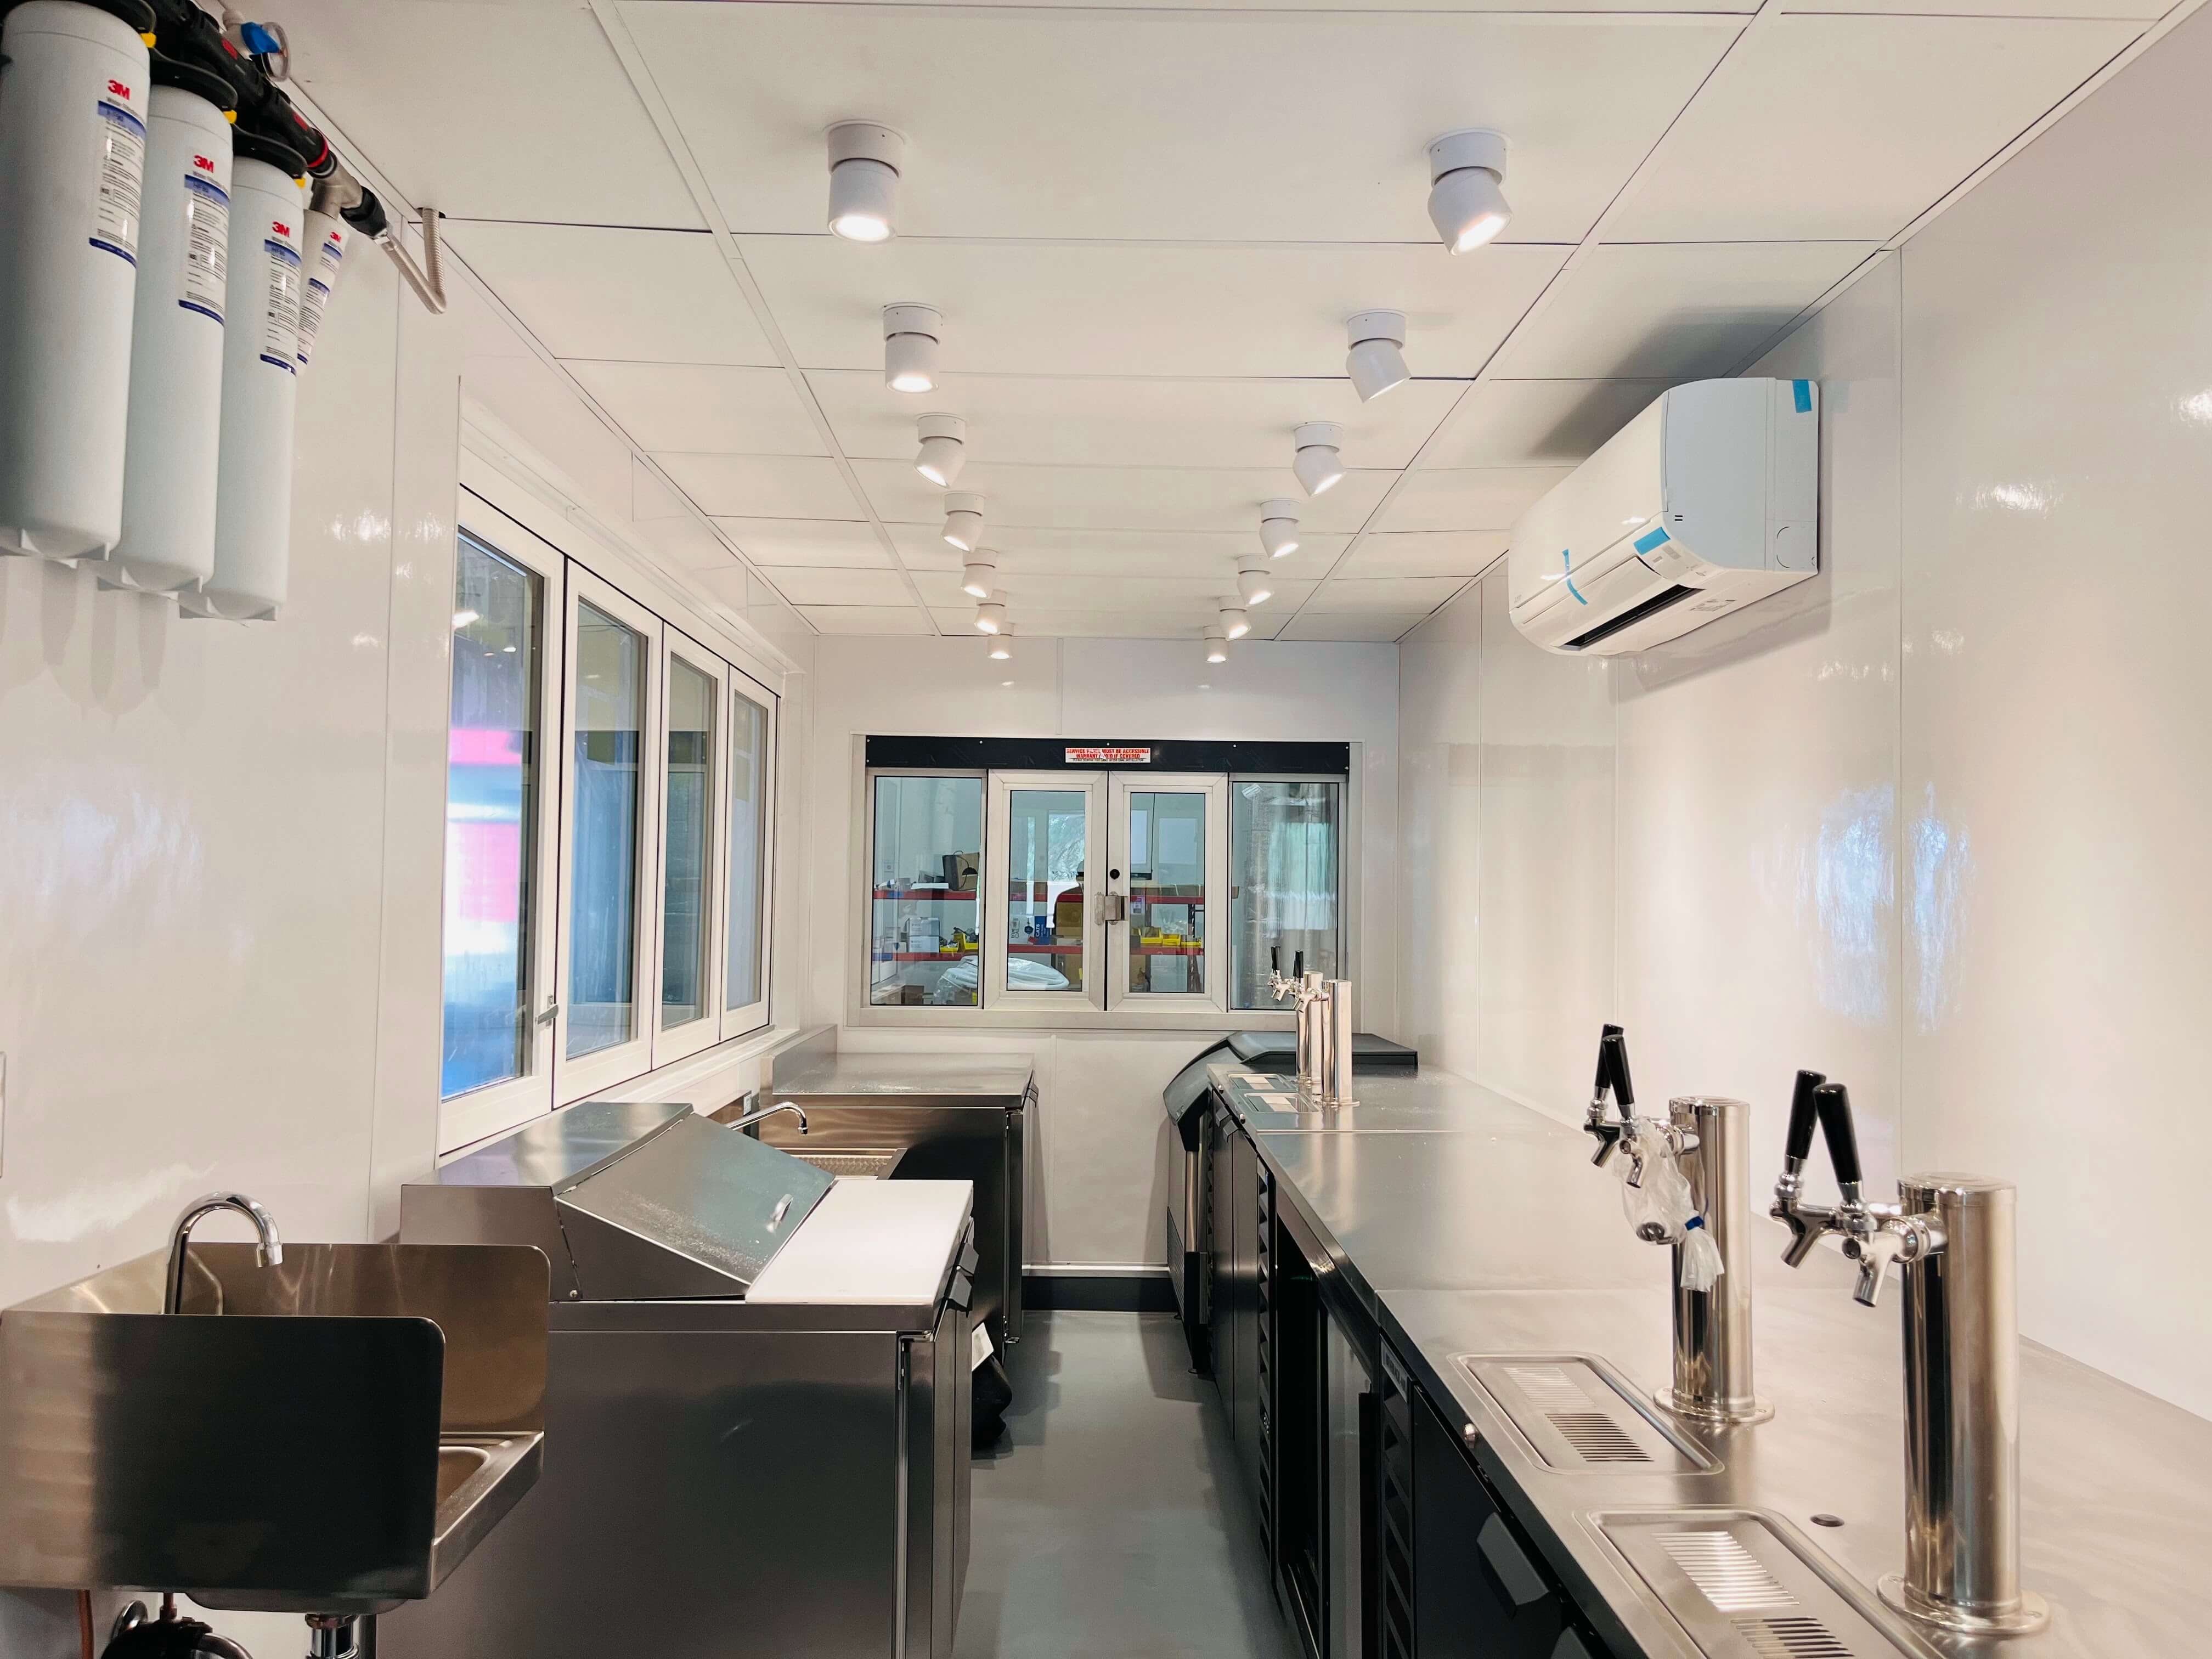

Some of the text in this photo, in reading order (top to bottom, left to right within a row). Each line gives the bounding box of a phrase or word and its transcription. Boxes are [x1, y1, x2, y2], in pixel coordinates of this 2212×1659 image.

[108, 80, 129, 100] 3M
[194, 155, 214, 173] 3M
[272, 221, 290, 238] 3M
[330, 232, 341, 242] 3M
